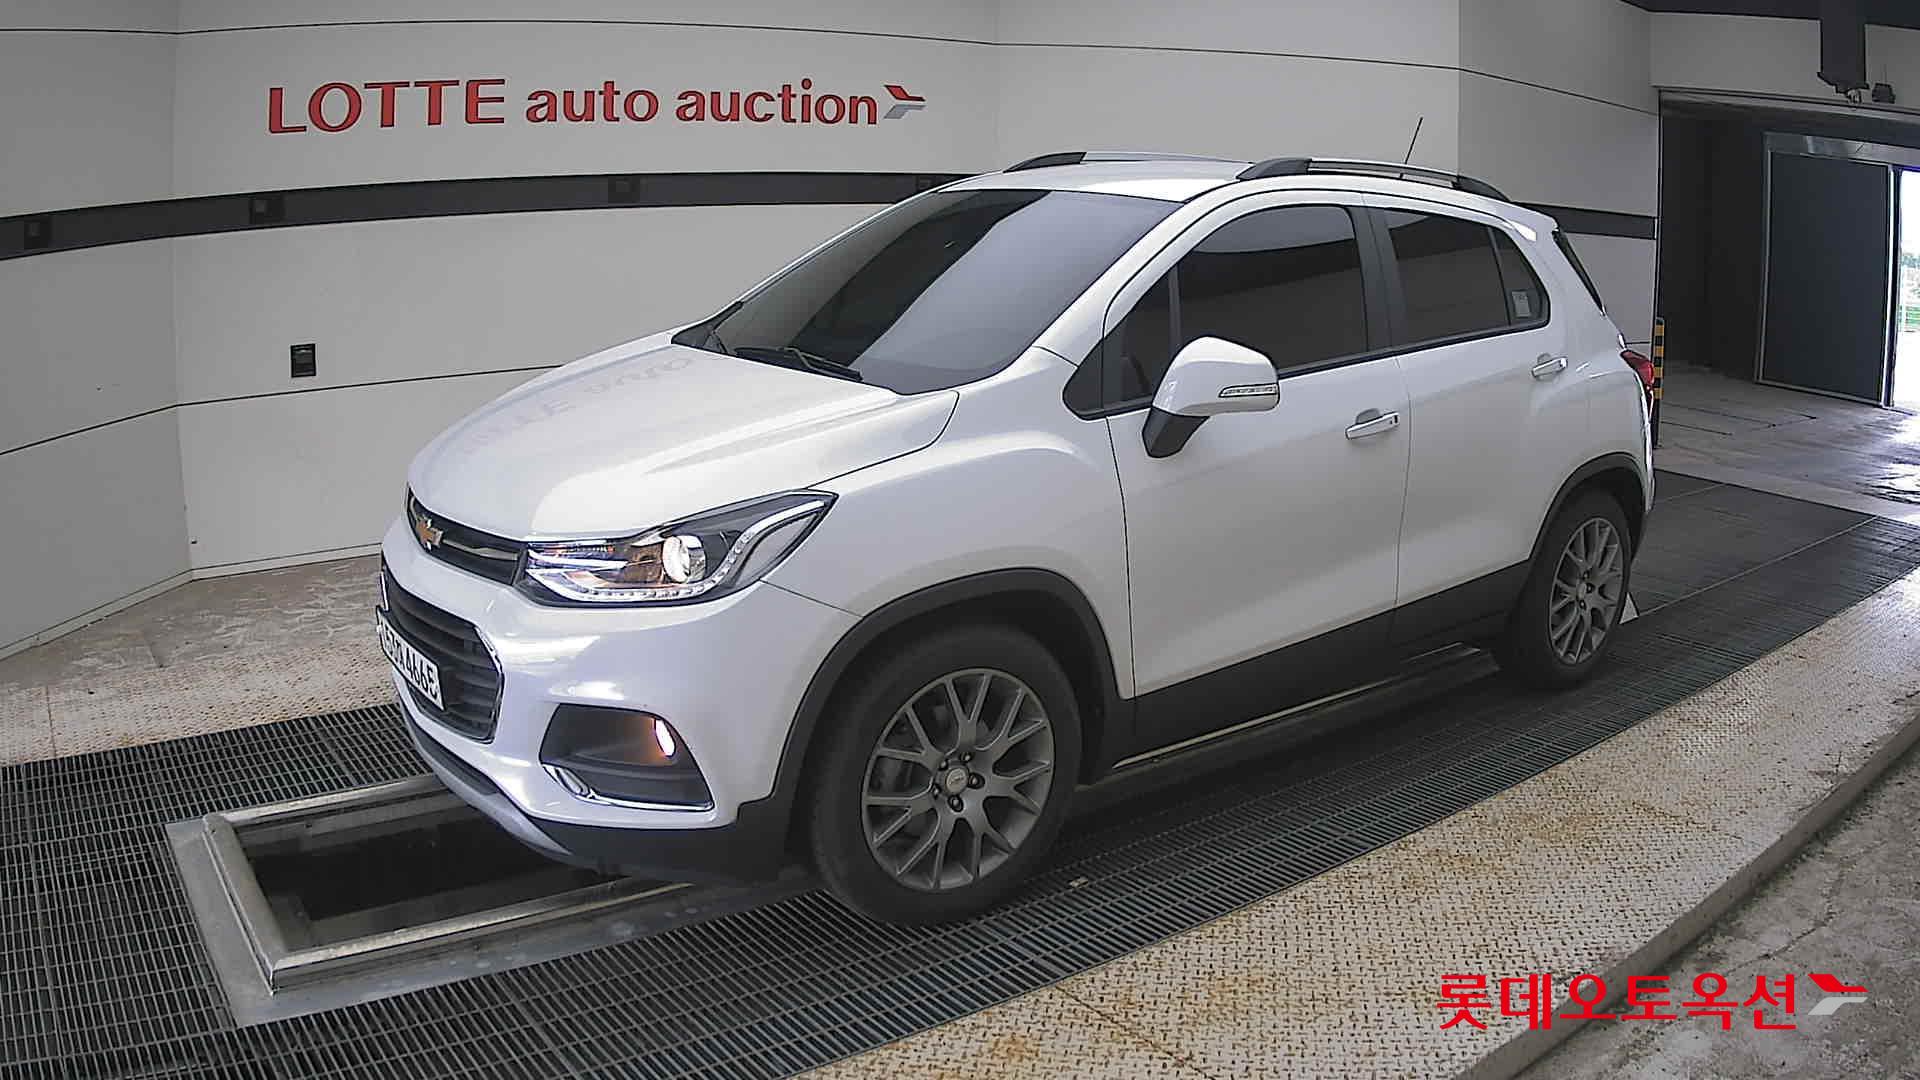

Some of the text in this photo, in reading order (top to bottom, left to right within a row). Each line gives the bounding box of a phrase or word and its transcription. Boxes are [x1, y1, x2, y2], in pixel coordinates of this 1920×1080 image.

[268, 78, 879, 134] LOTTE auto auction
